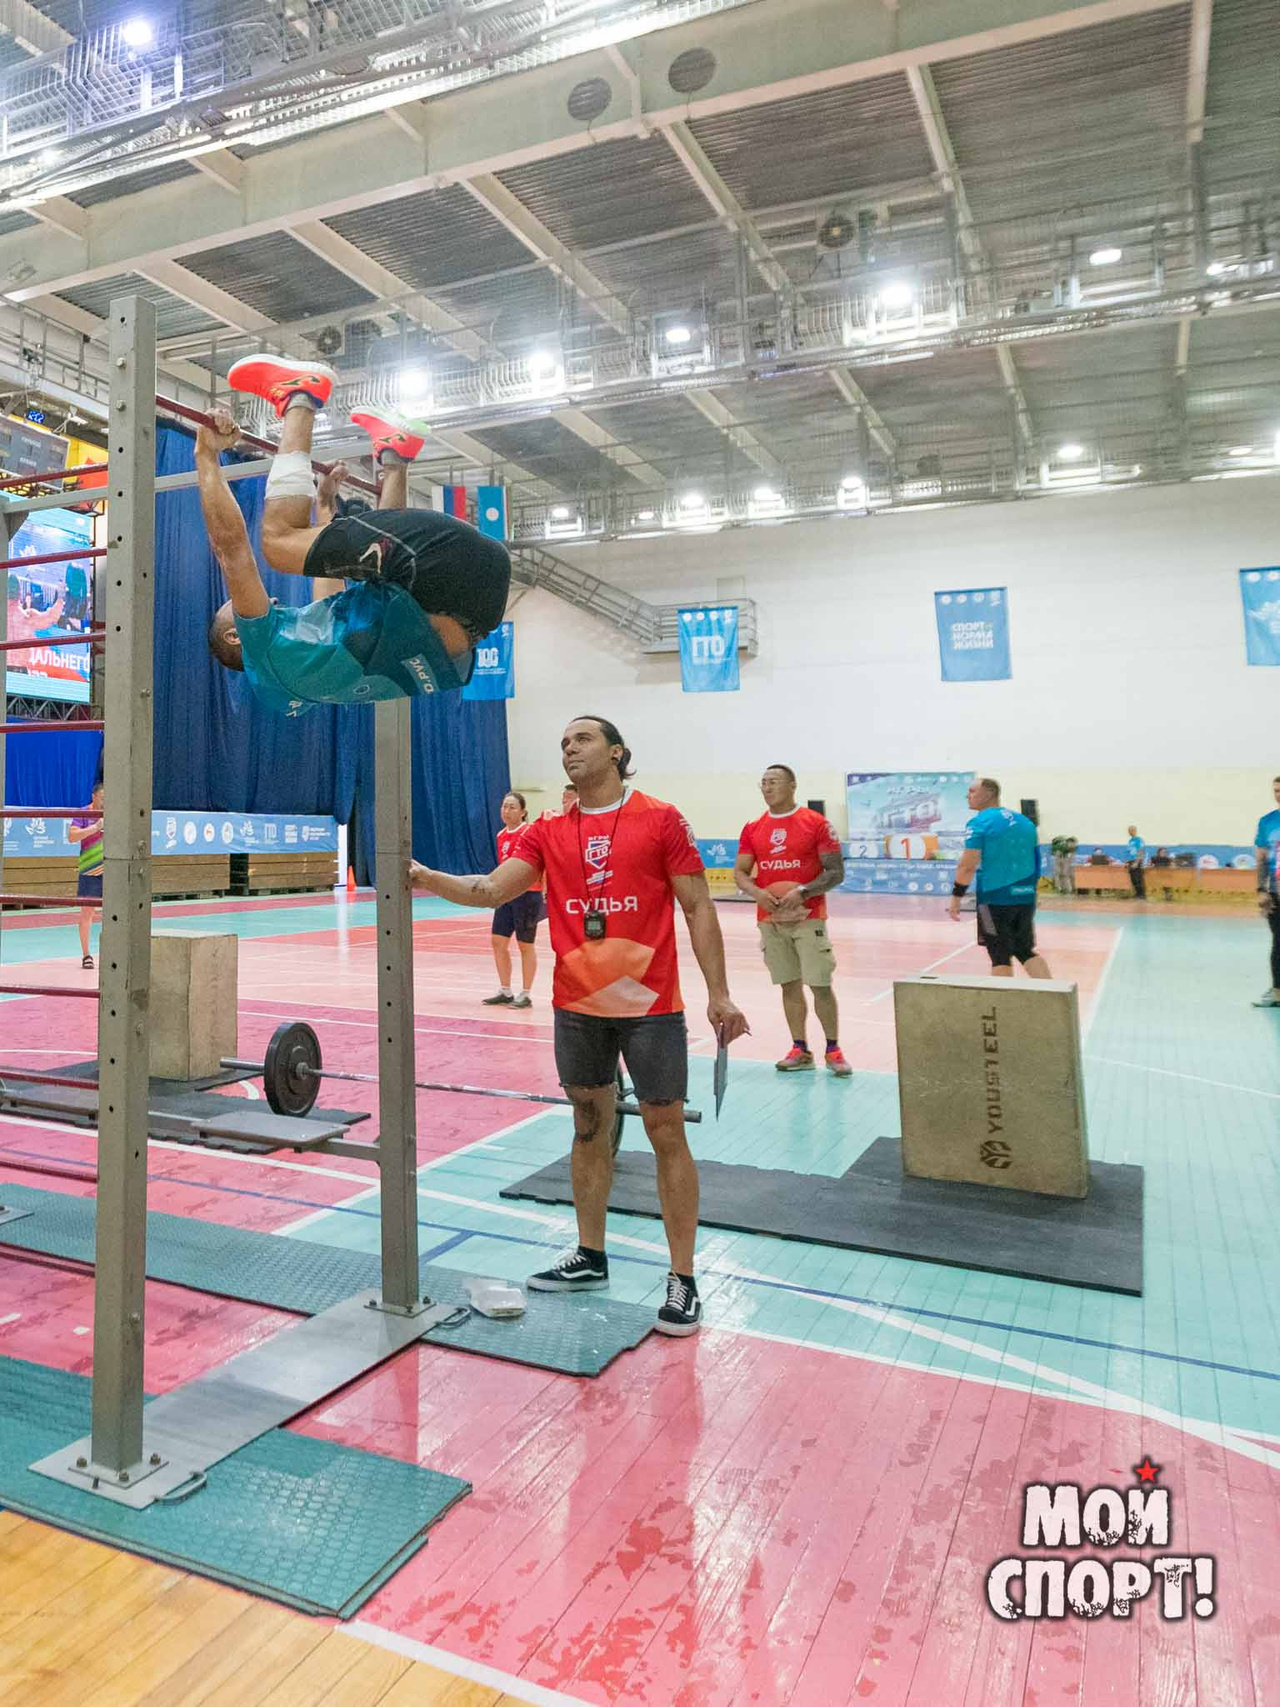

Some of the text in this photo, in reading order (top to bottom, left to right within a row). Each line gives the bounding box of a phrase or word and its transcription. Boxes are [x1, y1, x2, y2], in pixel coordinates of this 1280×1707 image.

[589, 846, 609, 859] ГТО
[901, 837, 911, 861] 1
[760, 859, 802, 870] СУДЬЯ
[565, 896, 639, 916] СУДЬЯ
[981, 1006, 1004, 1134] YOUSTEEL
